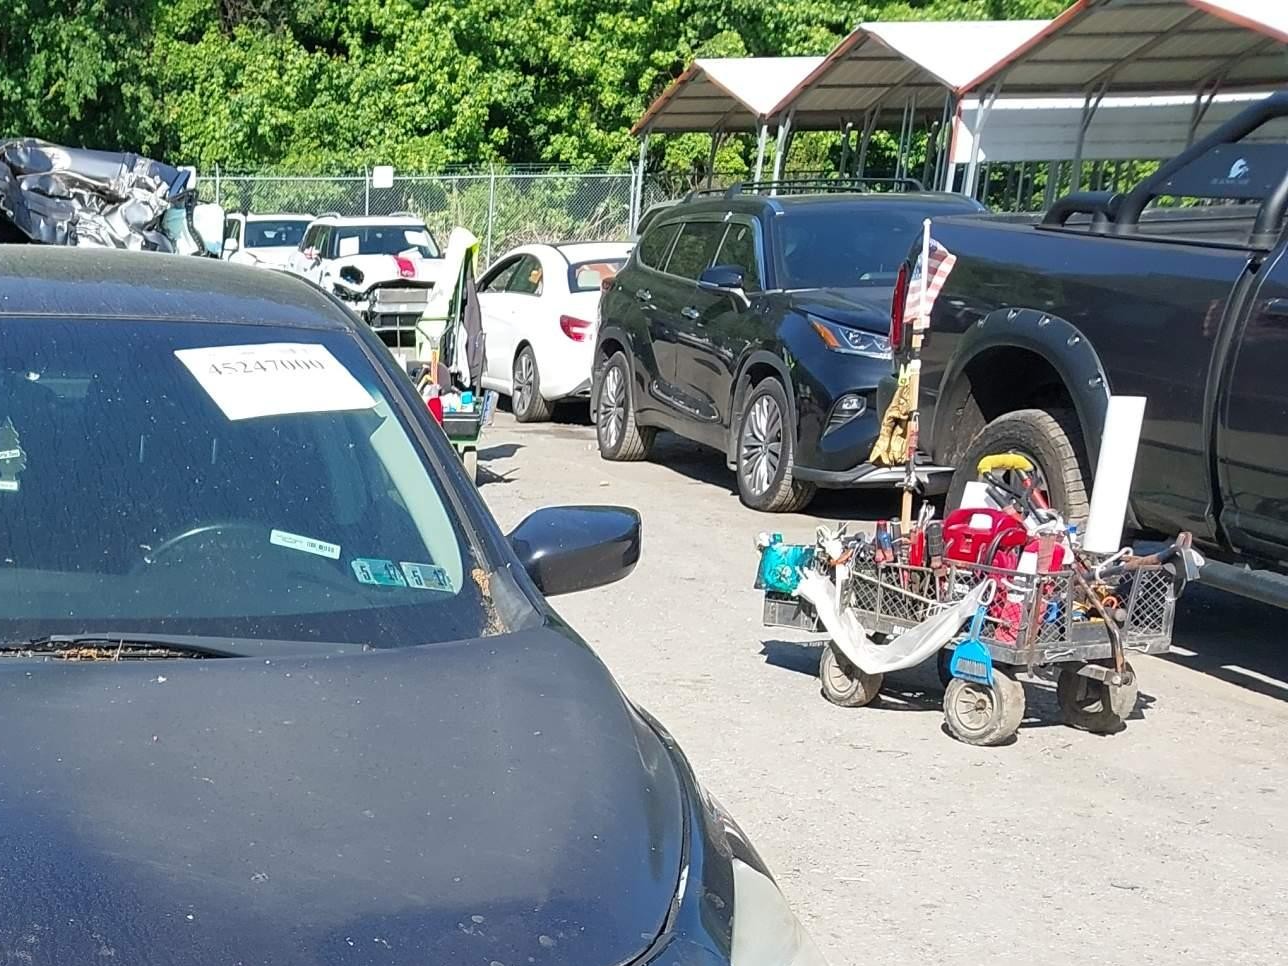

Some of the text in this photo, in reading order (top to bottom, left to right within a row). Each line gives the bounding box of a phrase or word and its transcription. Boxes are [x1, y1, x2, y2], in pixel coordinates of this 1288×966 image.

[208, 359, 328, 377] 45247000
[360, 565, 371, 581] 5
[412, 569, 449, 586] 5 17
